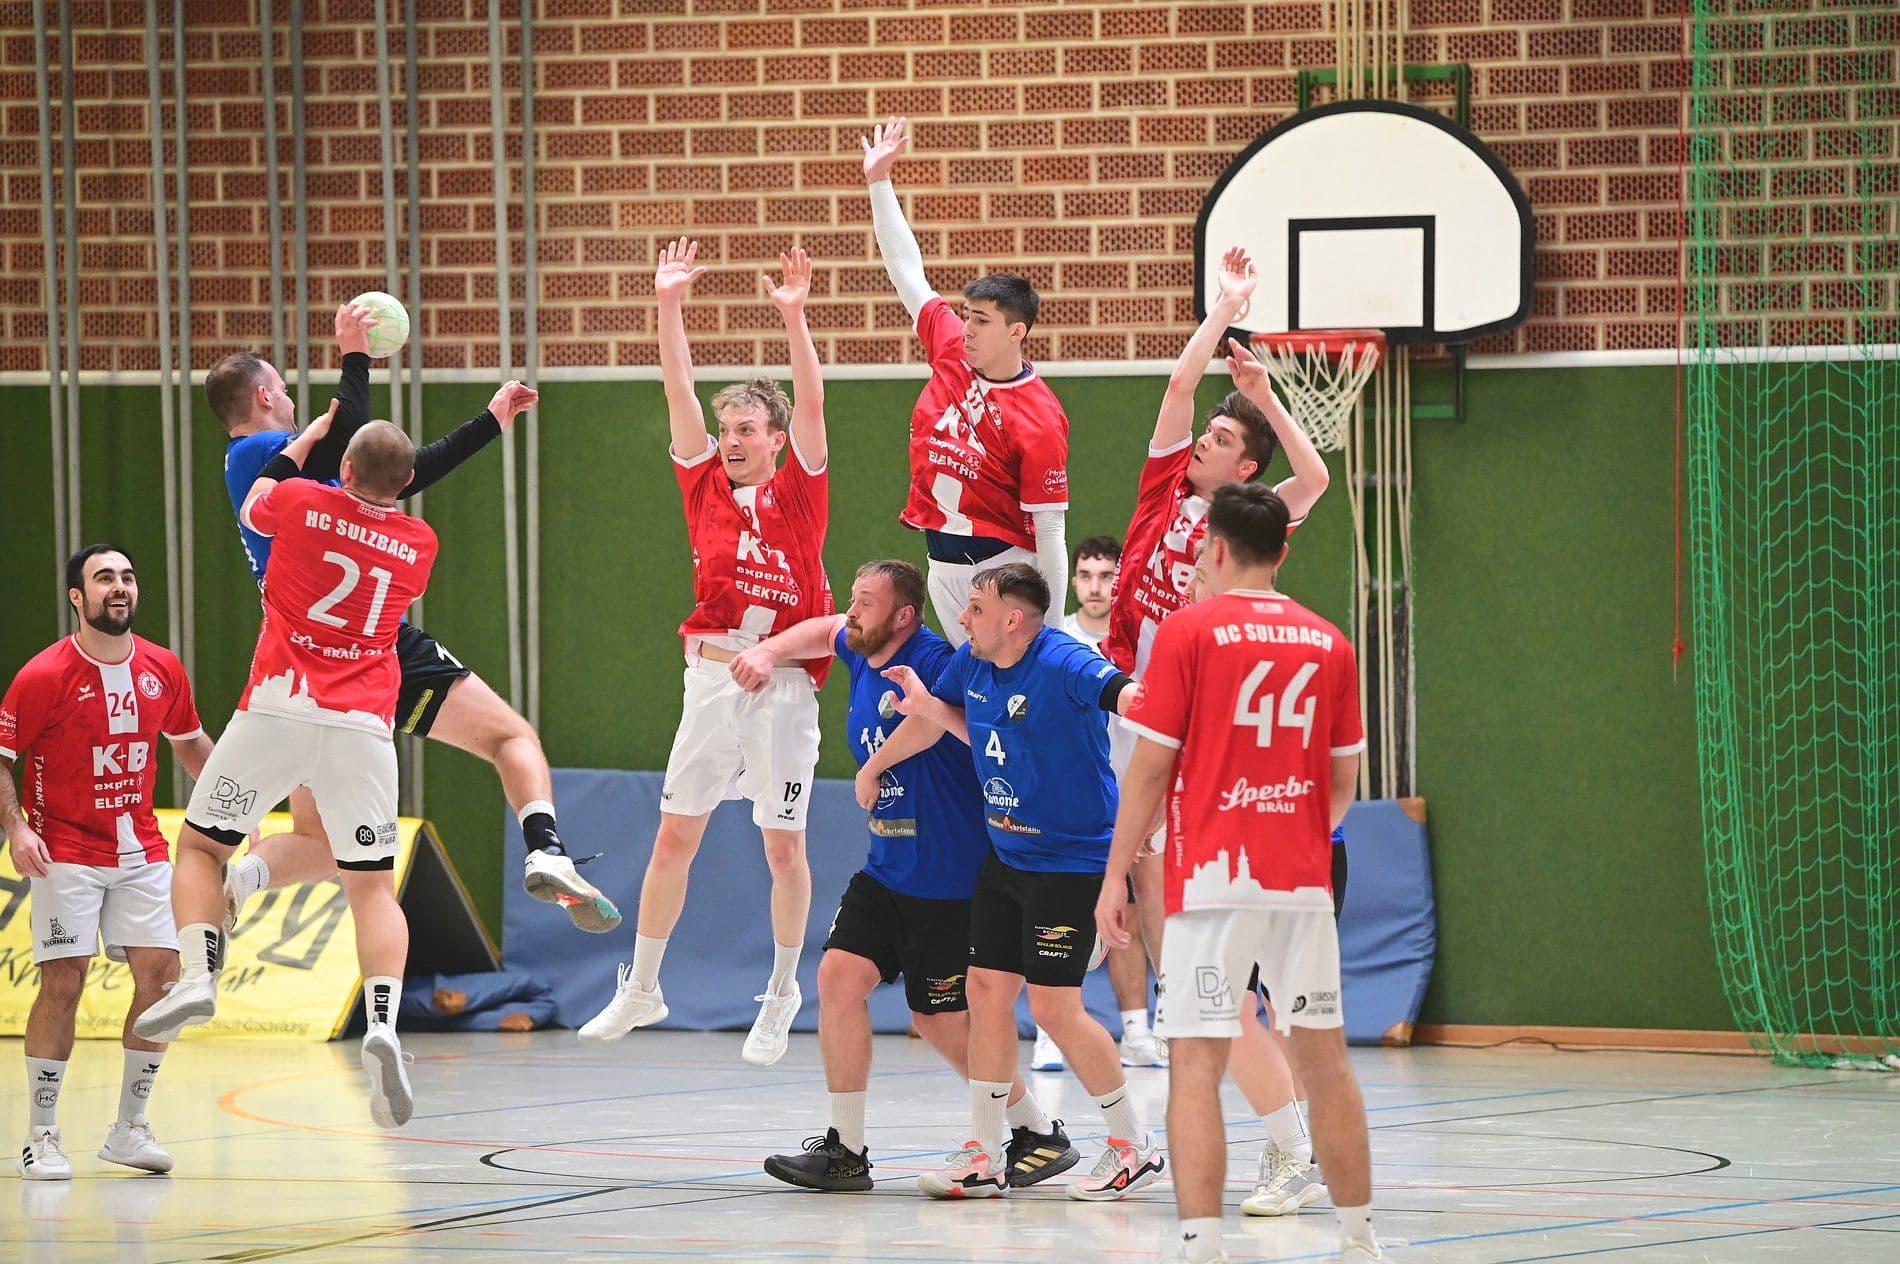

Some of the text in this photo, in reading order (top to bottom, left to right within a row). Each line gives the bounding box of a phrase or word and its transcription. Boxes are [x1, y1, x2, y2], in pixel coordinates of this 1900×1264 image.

[305, 510, 419, 566] HC SULZBACH
[736, 566, 785, 583] expert
[307, 550, 393, 638] 21
[734, 580, 799, 607] ELEKTRO
[1213, 623, 1333, 652] HC SULZBACH
[108, 691, 136, 717] 24
[1233, 660, 1320, 749] 44
[92, 741, 150, 777] K+B
[985, 730, 1006, 765] 4
[783, 781, 802, 803] 19
[360, 828, 373, 843] 89
